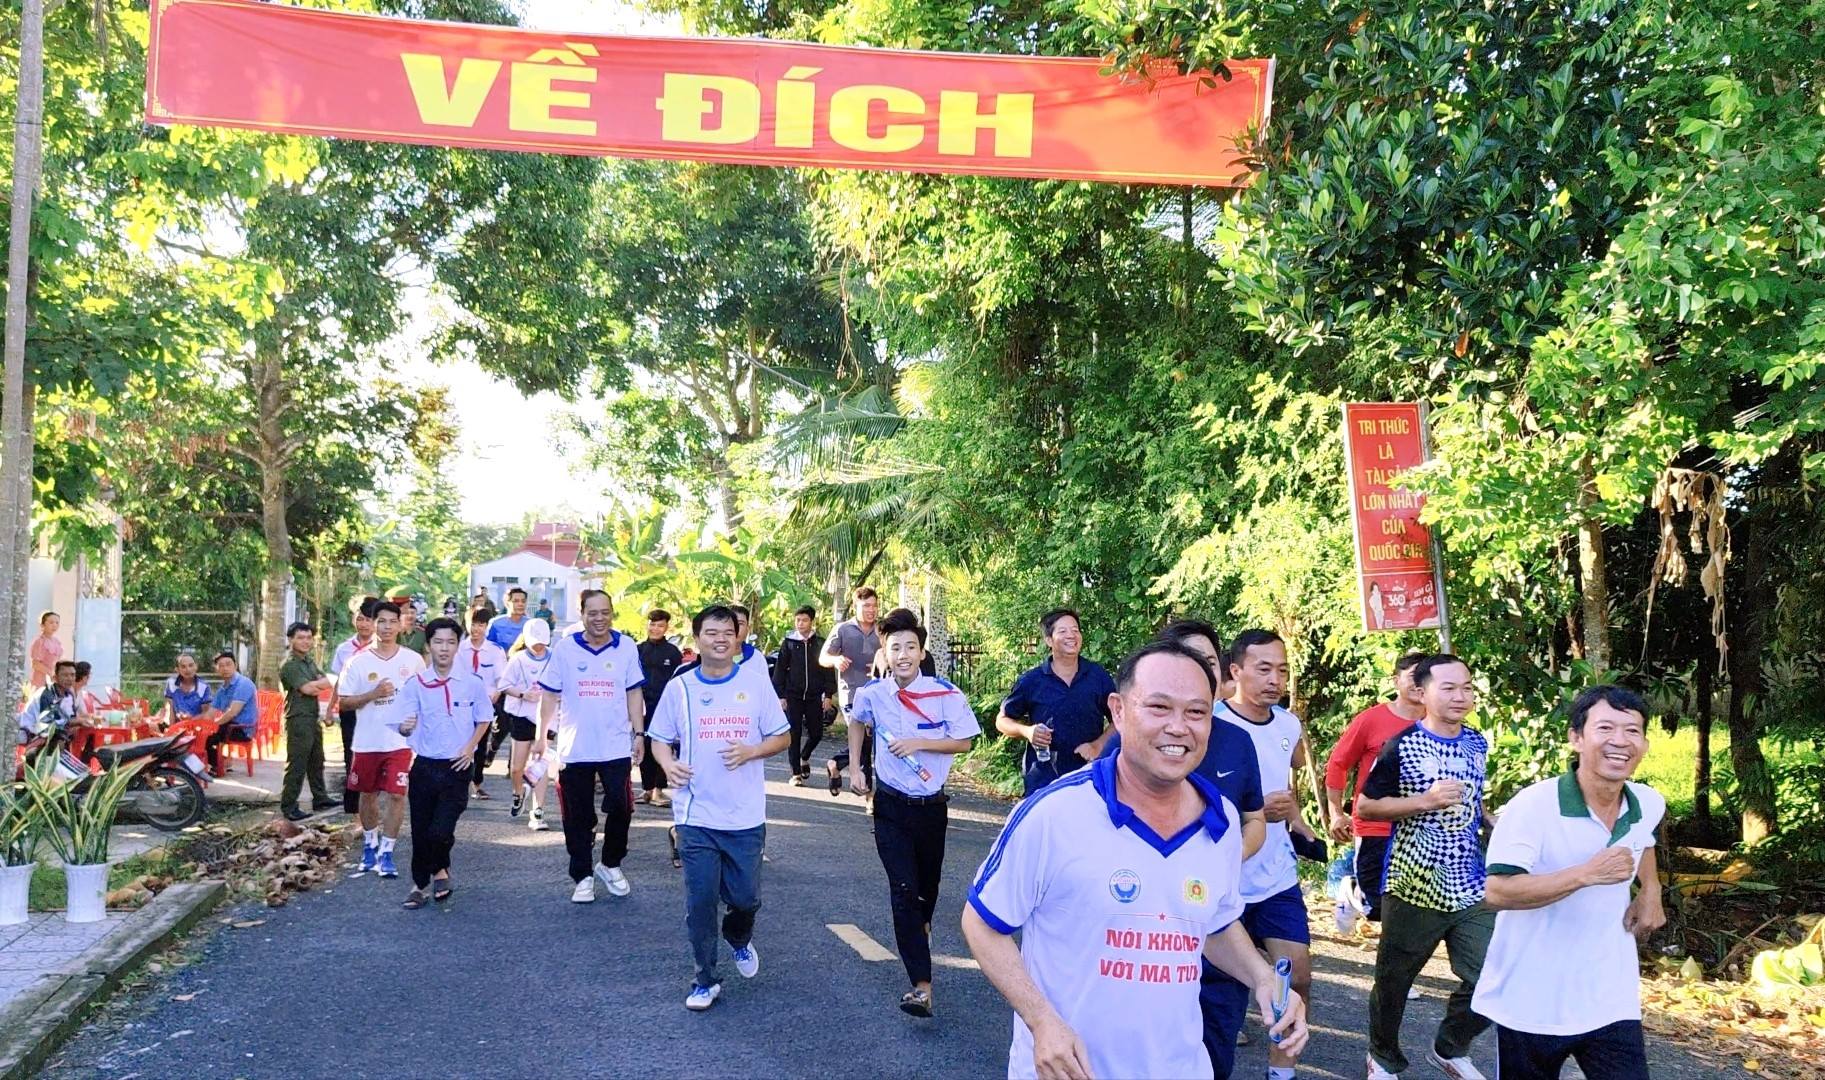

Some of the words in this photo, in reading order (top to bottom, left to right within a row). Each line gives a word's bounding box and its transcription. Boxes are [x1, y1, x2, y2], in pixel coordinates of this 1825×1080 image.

[401, 43, 599, 137] VỀ
[655, 67, 1034, 158] ĐÍCH
[1357, 419, 1377, 436] TRI
[1378, 441, 1394, 460] LÀ
[1382, 514, 1406, 535] CỦA
[1369, 540, 1401, 561] QUỐC
[1106, 927, 1143, 950] NÓI
[1147, 930, 1200, 952] KHÔNG
[1100, 957, 1134, 981] VỚI
[1139, 963, 1171, 984] MA
